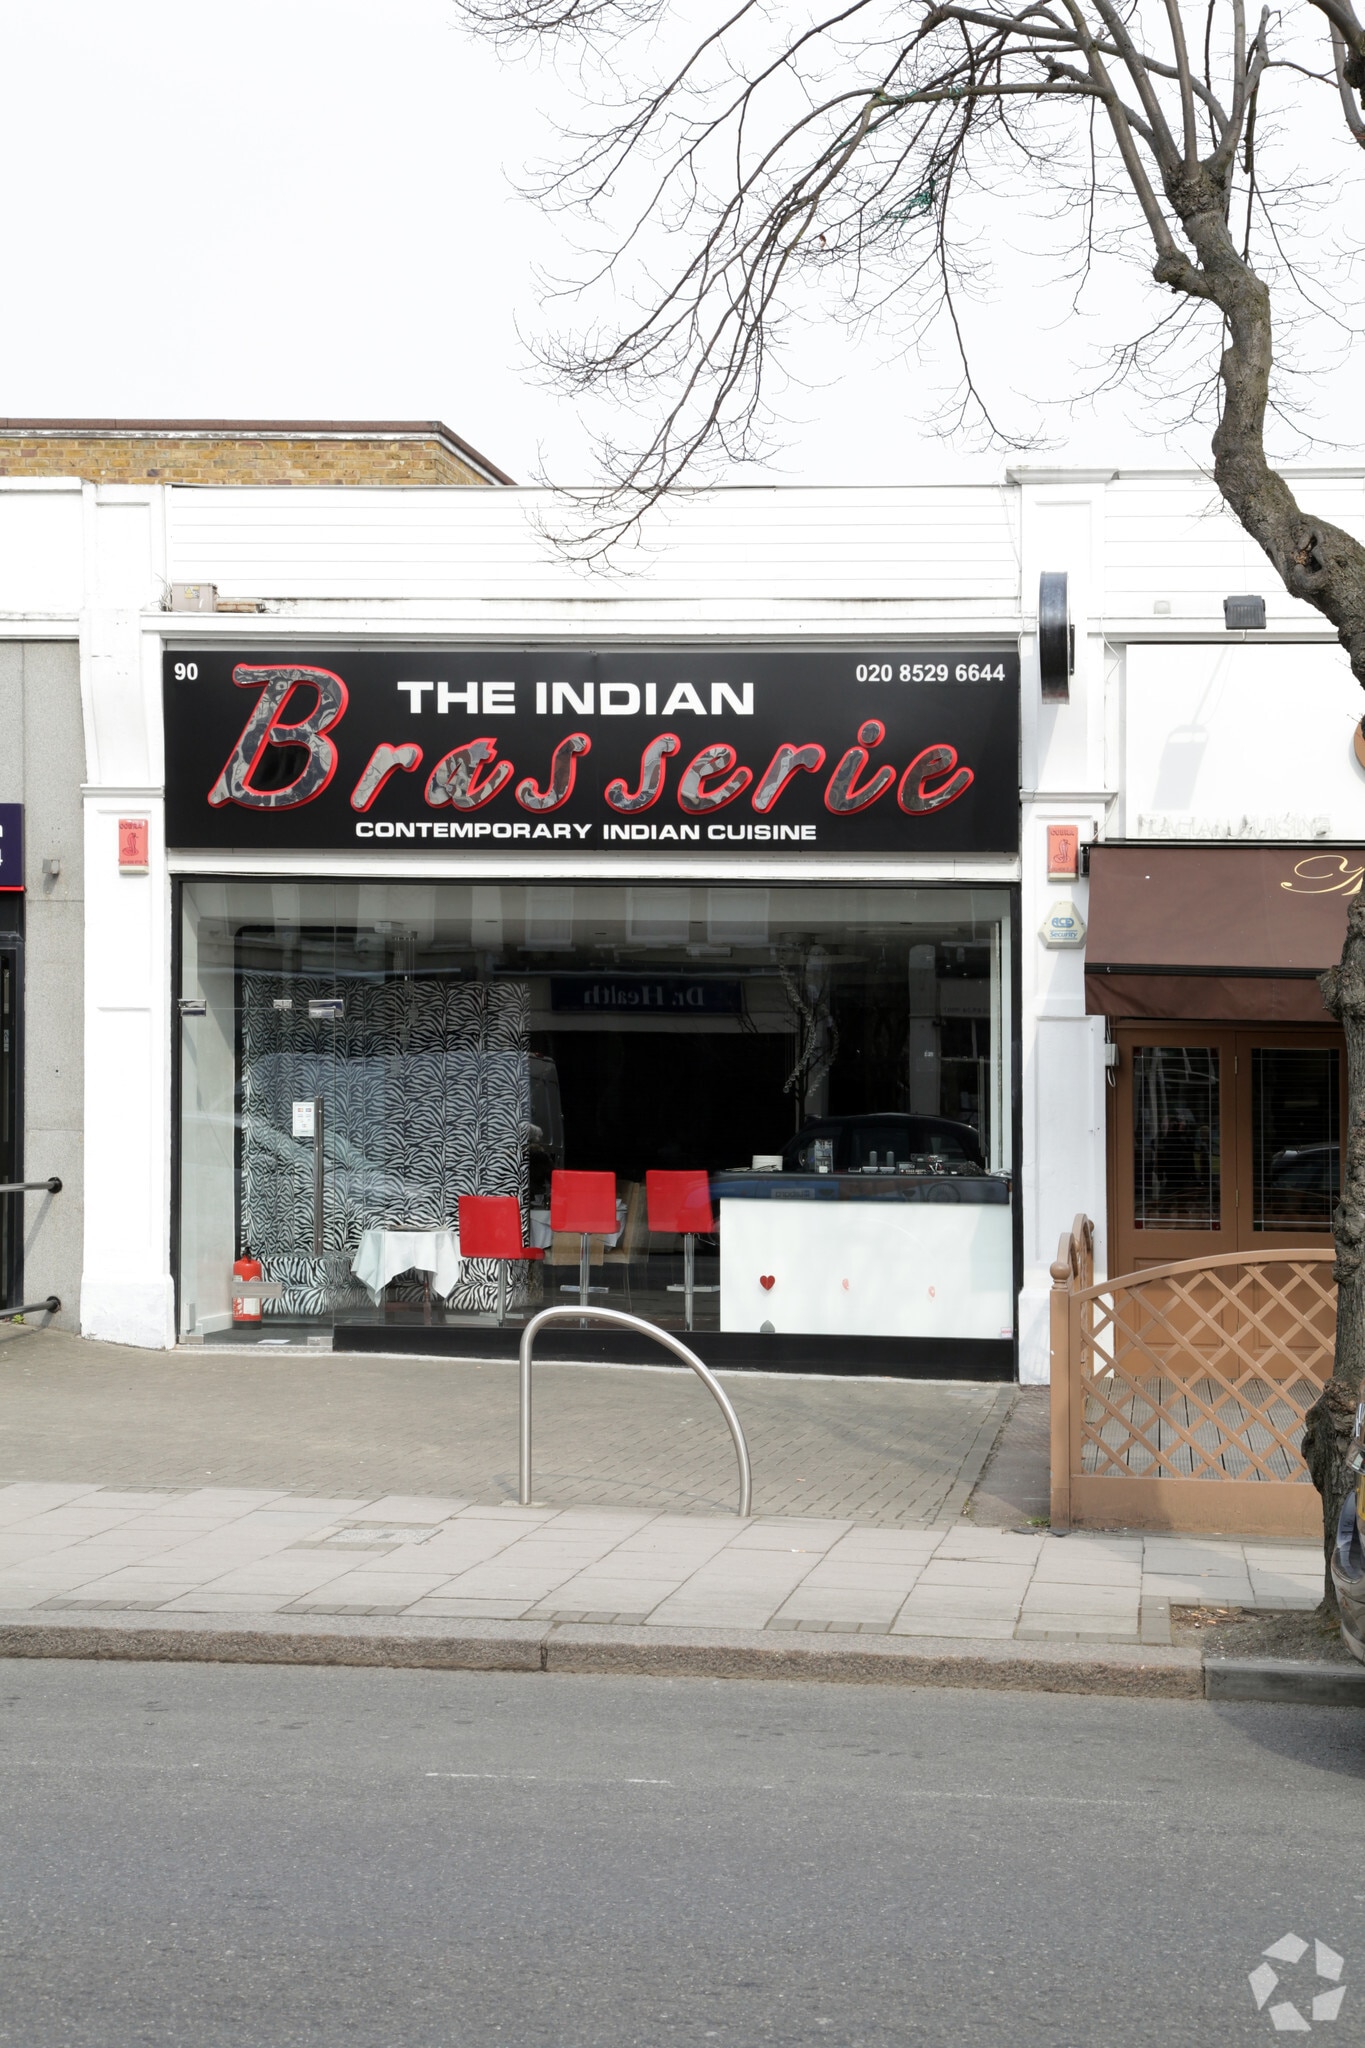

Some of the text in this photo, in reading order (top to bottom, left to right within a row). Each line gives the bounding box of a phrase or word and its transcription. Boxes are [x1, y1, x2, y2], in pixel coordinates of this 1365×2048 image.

[174, 662, 199, 681] 90
[855, 664, 1006, 682] 020 8529 6644
[397, 681, 755, 715] THE INDIAN
[207, 663, 975, 815] Brasserie
[355, 822, 817, 840] CONTEMPORARY INDIAN CUISINE
